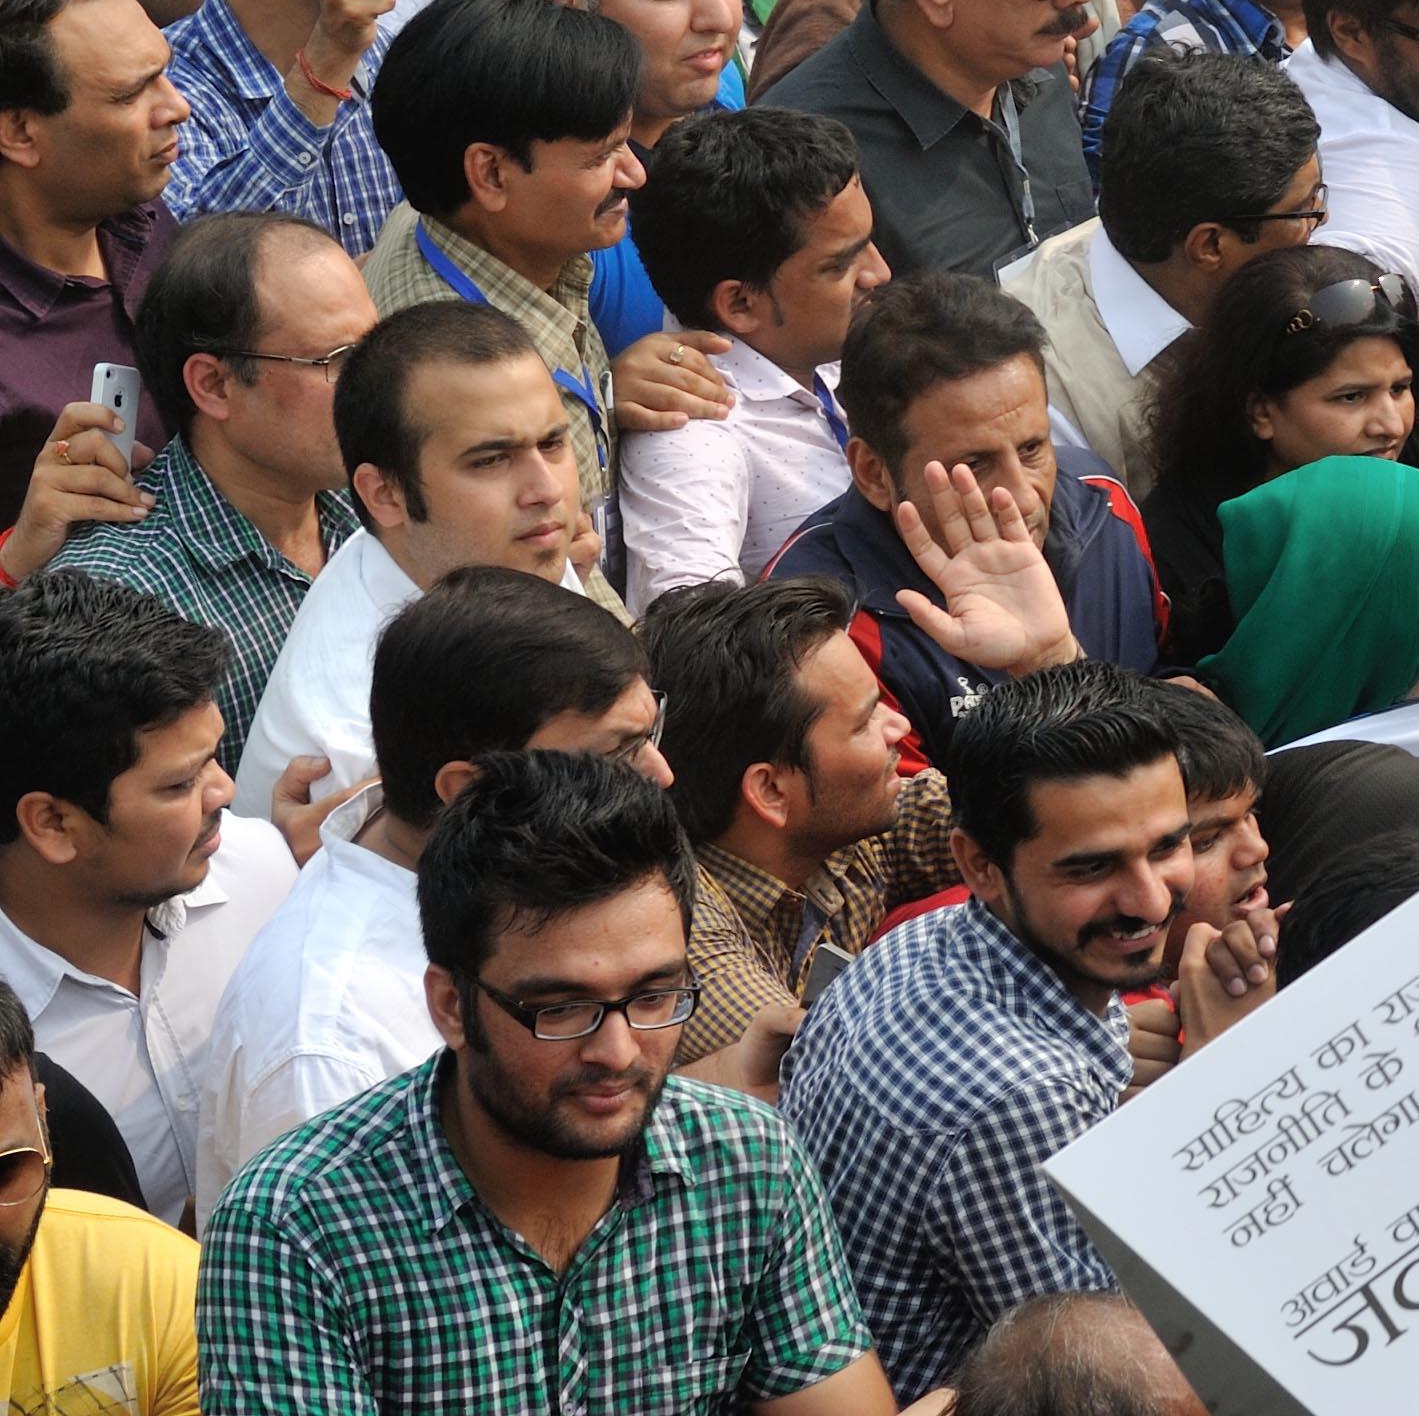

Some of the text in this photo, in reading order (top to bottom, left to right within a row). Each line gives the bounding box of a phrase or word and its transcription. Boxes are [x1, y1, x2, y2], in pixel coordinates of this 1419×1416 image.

[1172, 1065, 1309, 1171] साहित्य
[1310, 1019, 1371, 1070] का
[1198, 1089, 1352, 1209] राजनीति
[1358, 1048, 1404, 1091] के
[1223, 1173, 1304, 1248] नहीं
[1281, 1235, 1378, 1326] अवार्ड
